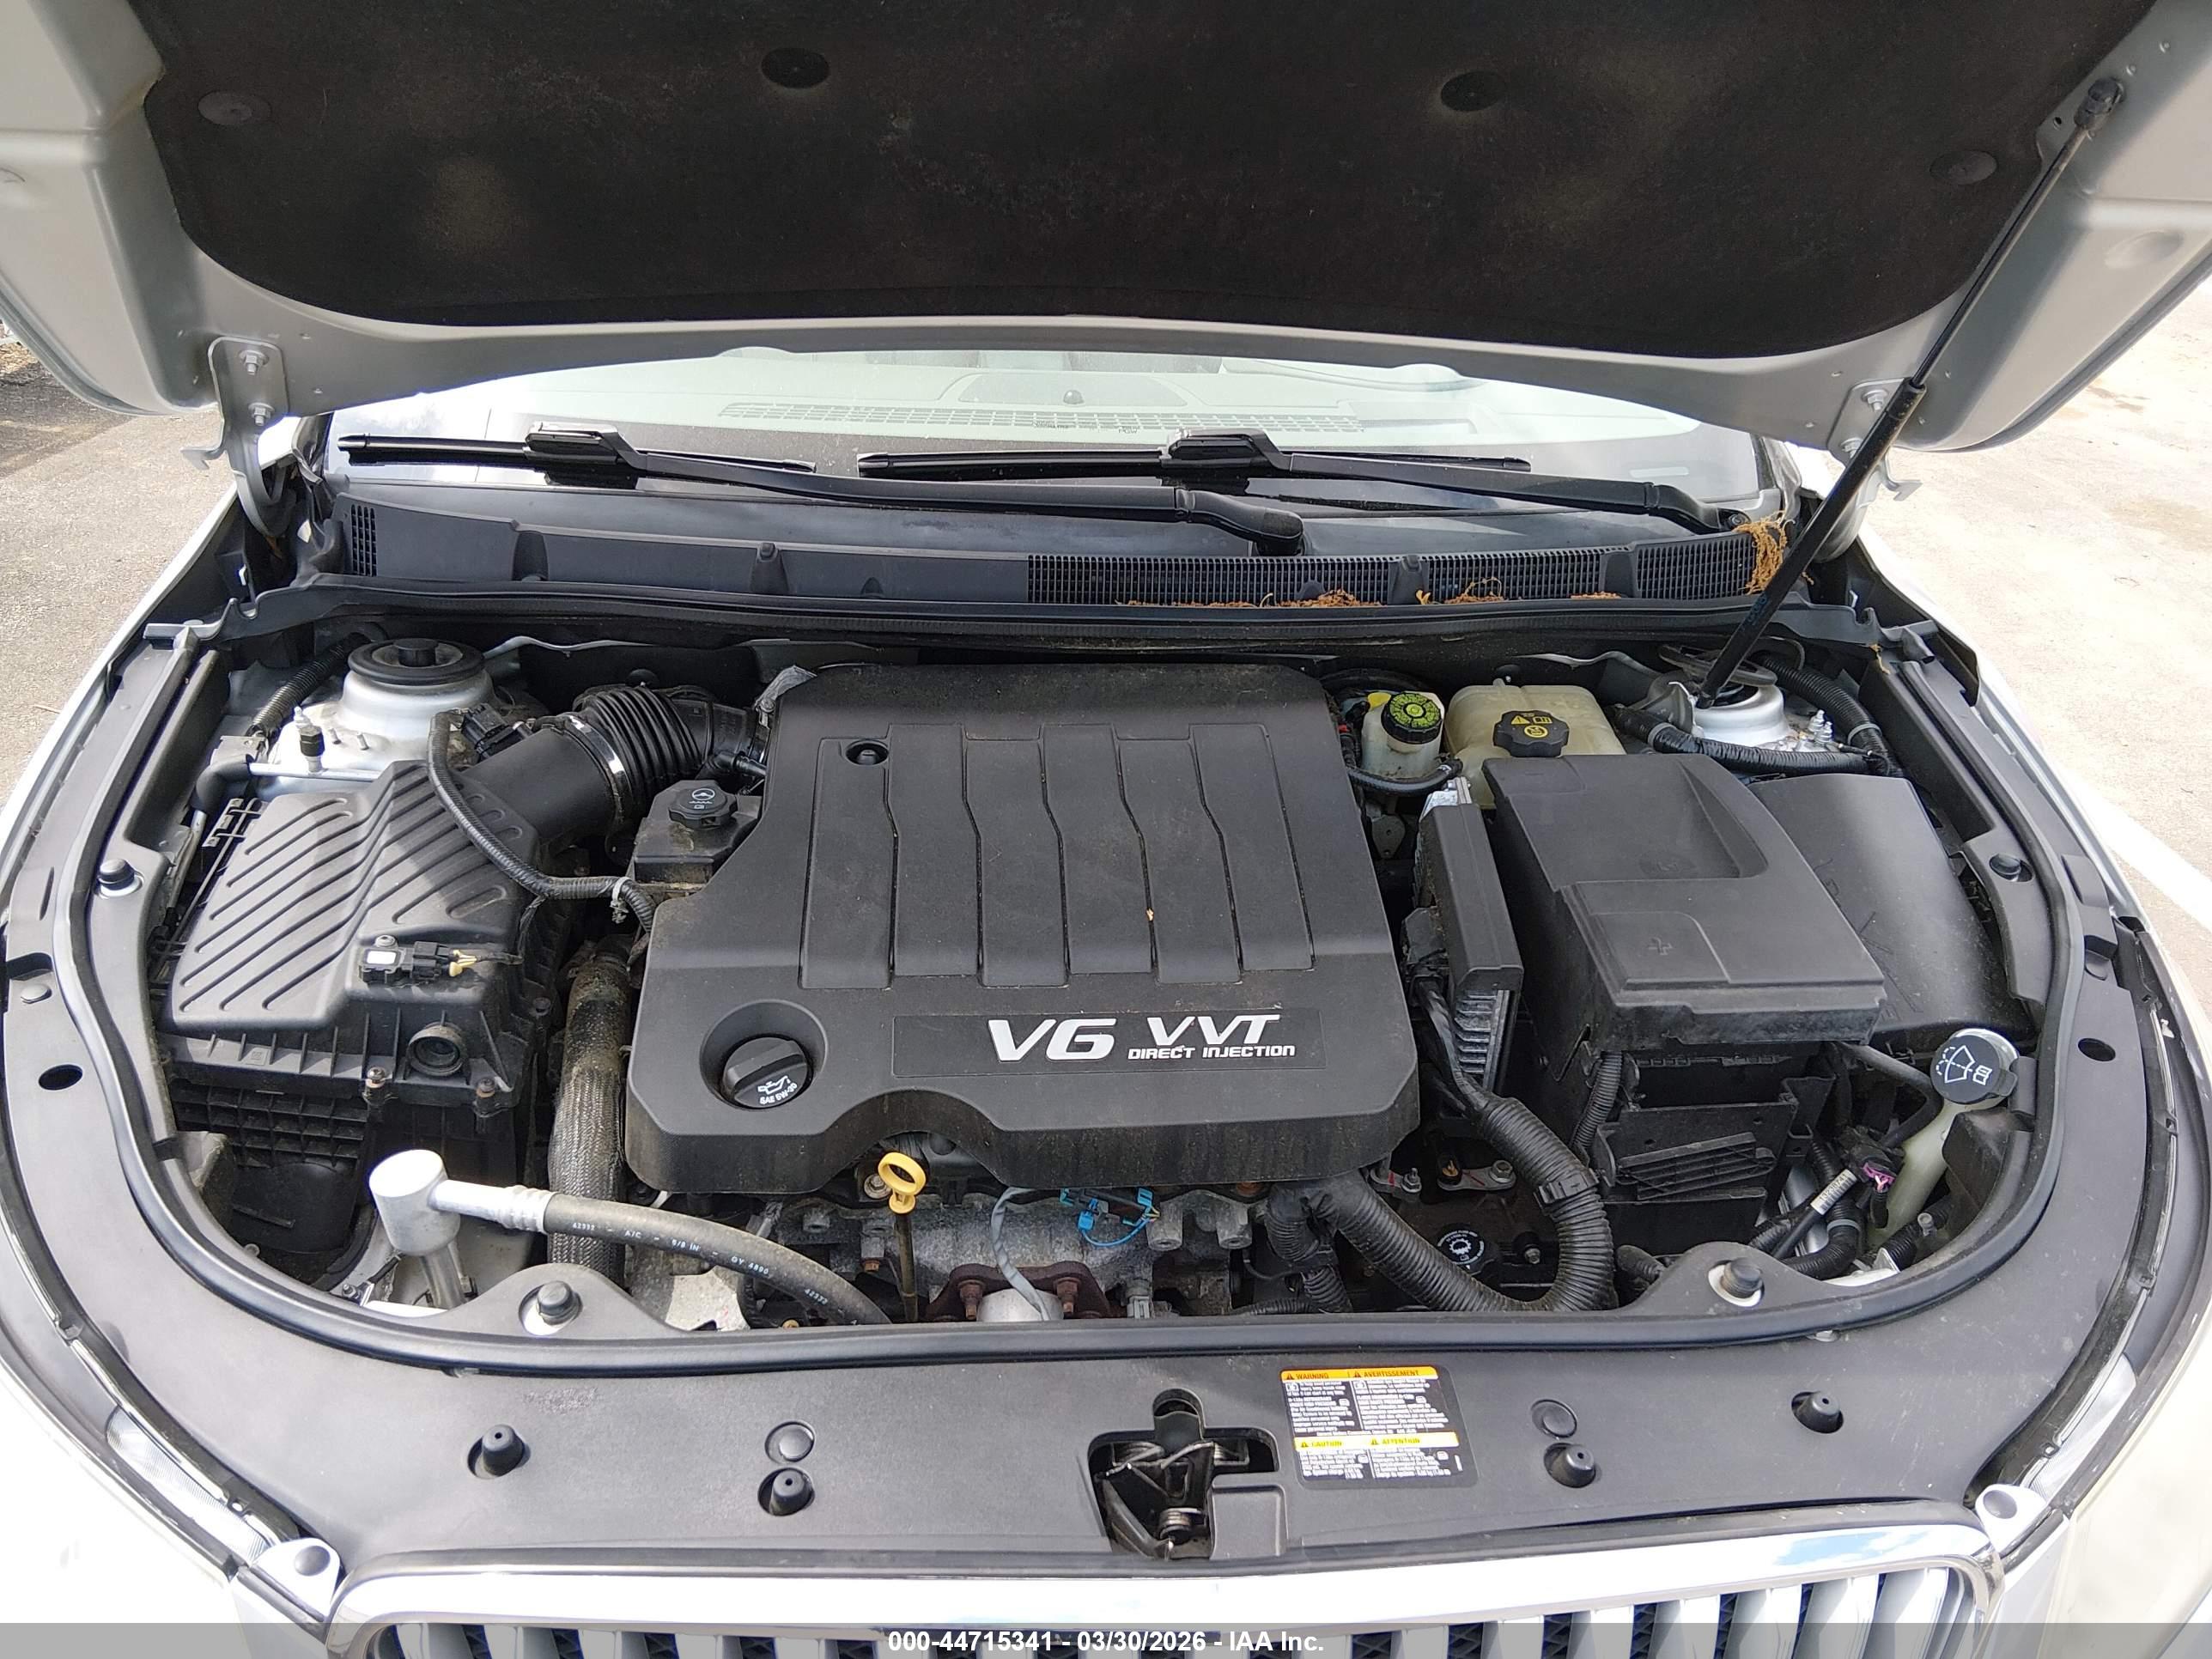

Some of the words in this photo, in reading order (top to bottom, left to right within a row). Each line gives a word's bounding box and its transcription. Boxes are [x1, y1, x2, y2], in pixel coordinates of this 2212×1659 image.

[988, 1018, 1116, 1061] V6
[1146, 1015, 1280, 1045] VVT
[1127, 1047, 1196, 1060] DIRECT
[1202, 1045, 1296, 1059] INJECTION
[760, 1095, 775, 1104] SAE
[624, 1230, 641, 1238] A/C
